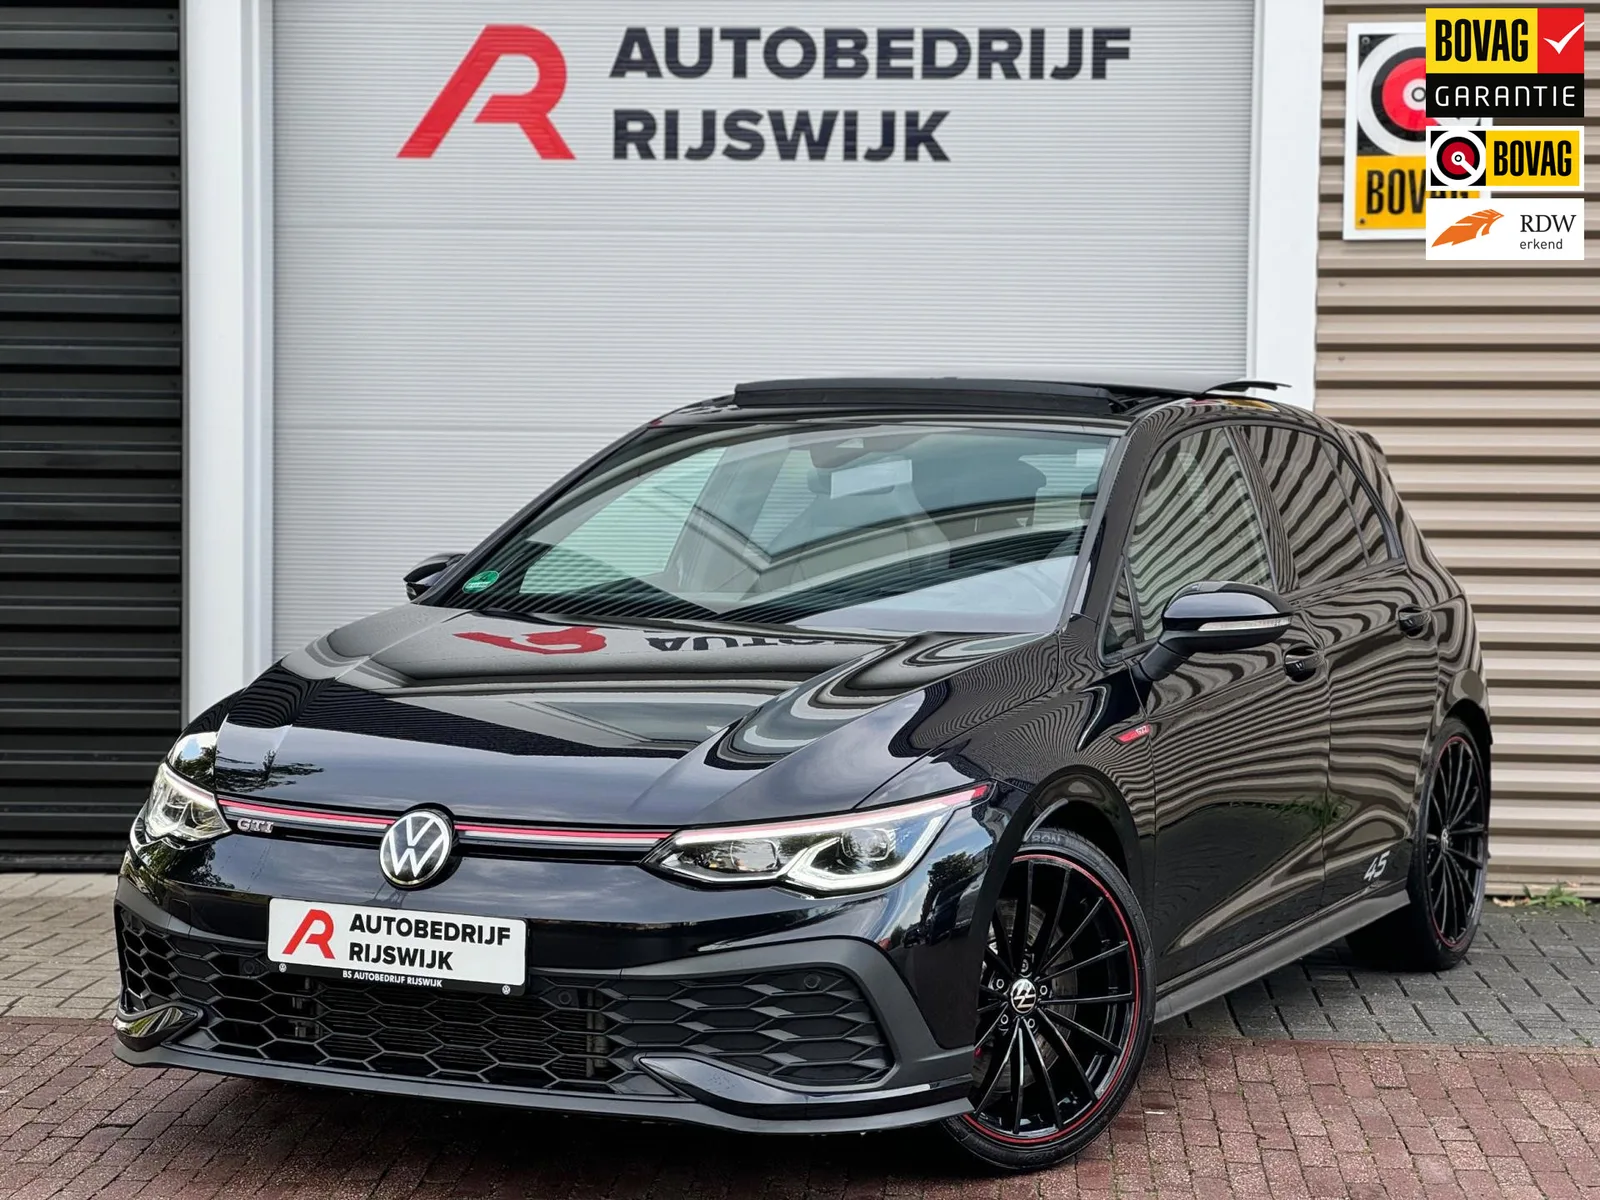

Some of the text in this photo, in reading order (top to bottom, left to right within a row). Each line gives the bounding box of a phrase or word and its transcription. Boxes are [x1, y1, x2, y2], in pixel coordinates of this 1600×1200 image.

[609, 26, 1132, 81] AUTOBEDRIJF
[612, 108, 952, 163] RIJSWIJK
[236, 817, 275, 834] GTI
[1363, 850, 1390, 882] 45
[349, 913, 511, 946] AUTOBEDRIJF
[348, 942, 454, 971] RIJSWIJK
[342, 970, 443, 988] BS AUTOBEDRIJF RIJSWIJK
